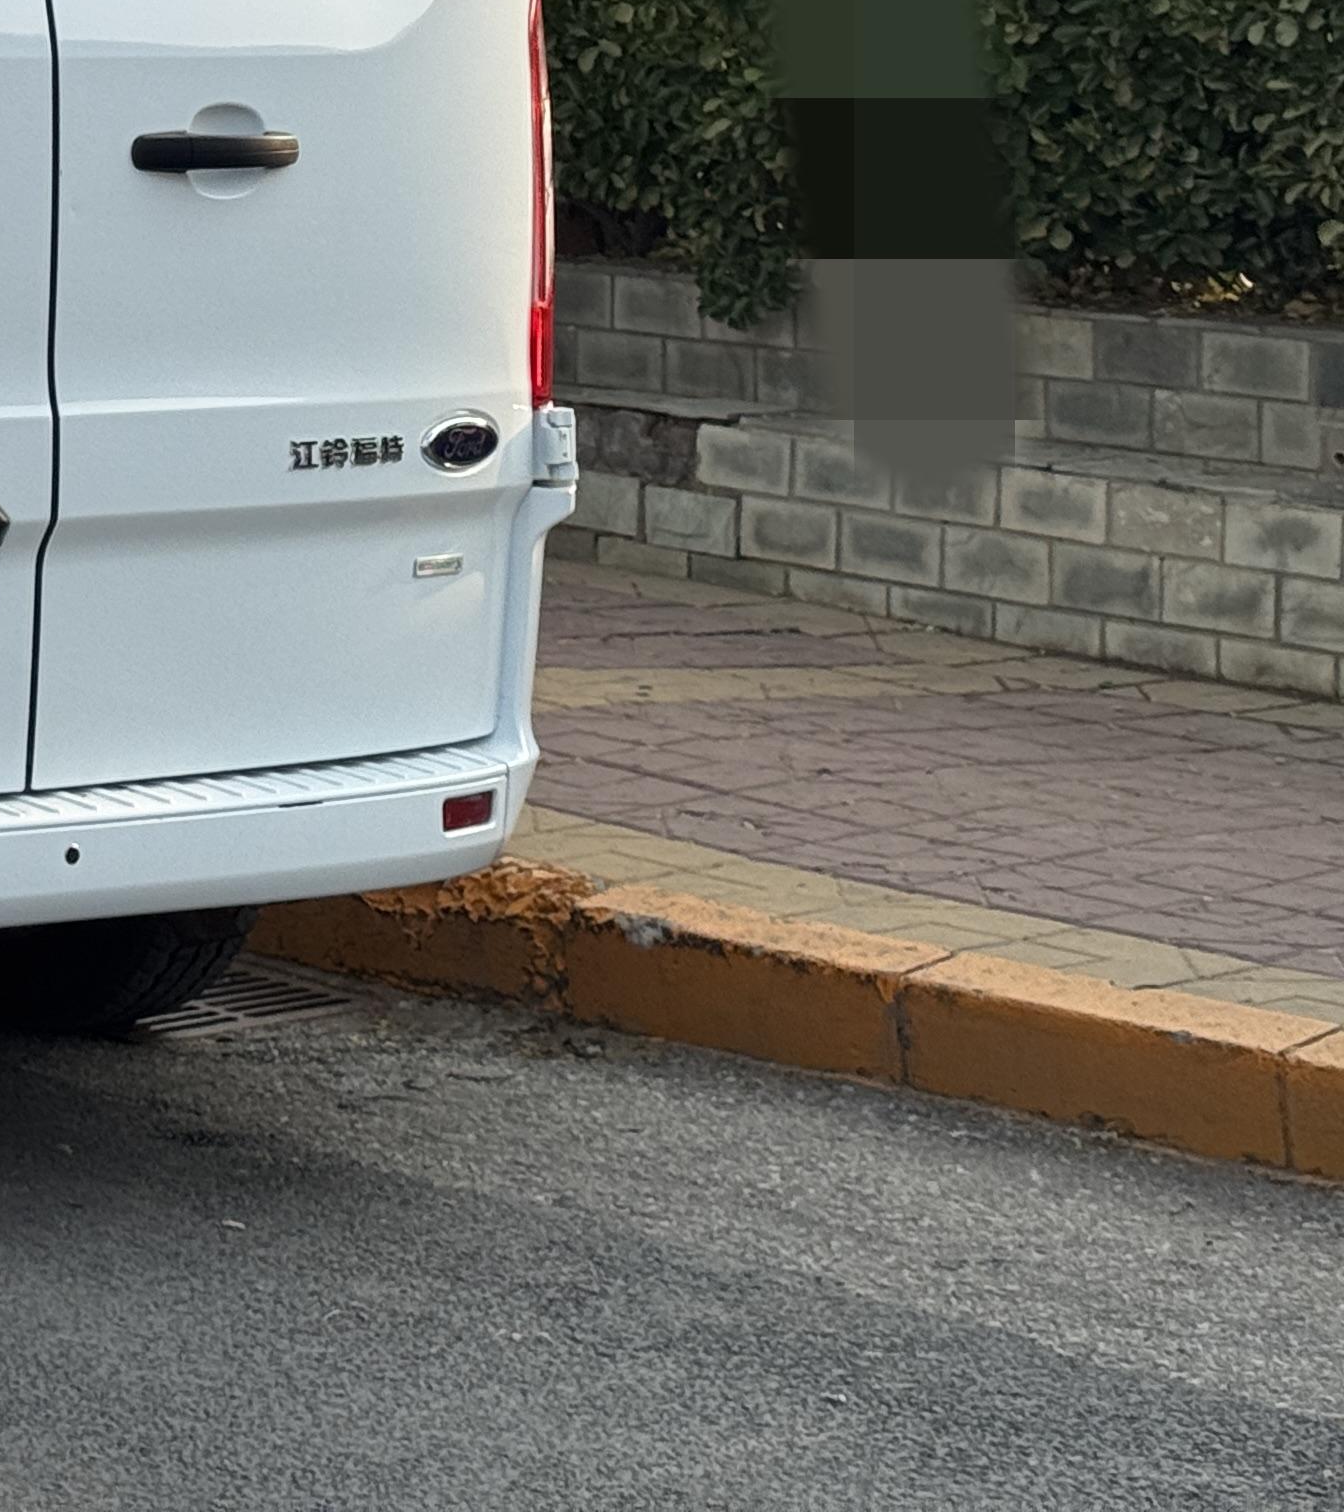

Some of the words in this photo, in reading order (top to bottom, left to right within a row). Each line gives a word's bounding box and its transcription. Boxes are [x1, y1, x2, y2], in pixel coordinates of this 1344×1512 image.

[288, 435, 405, 471] 江铃福特
[444, 428, 486, 458] Ford
